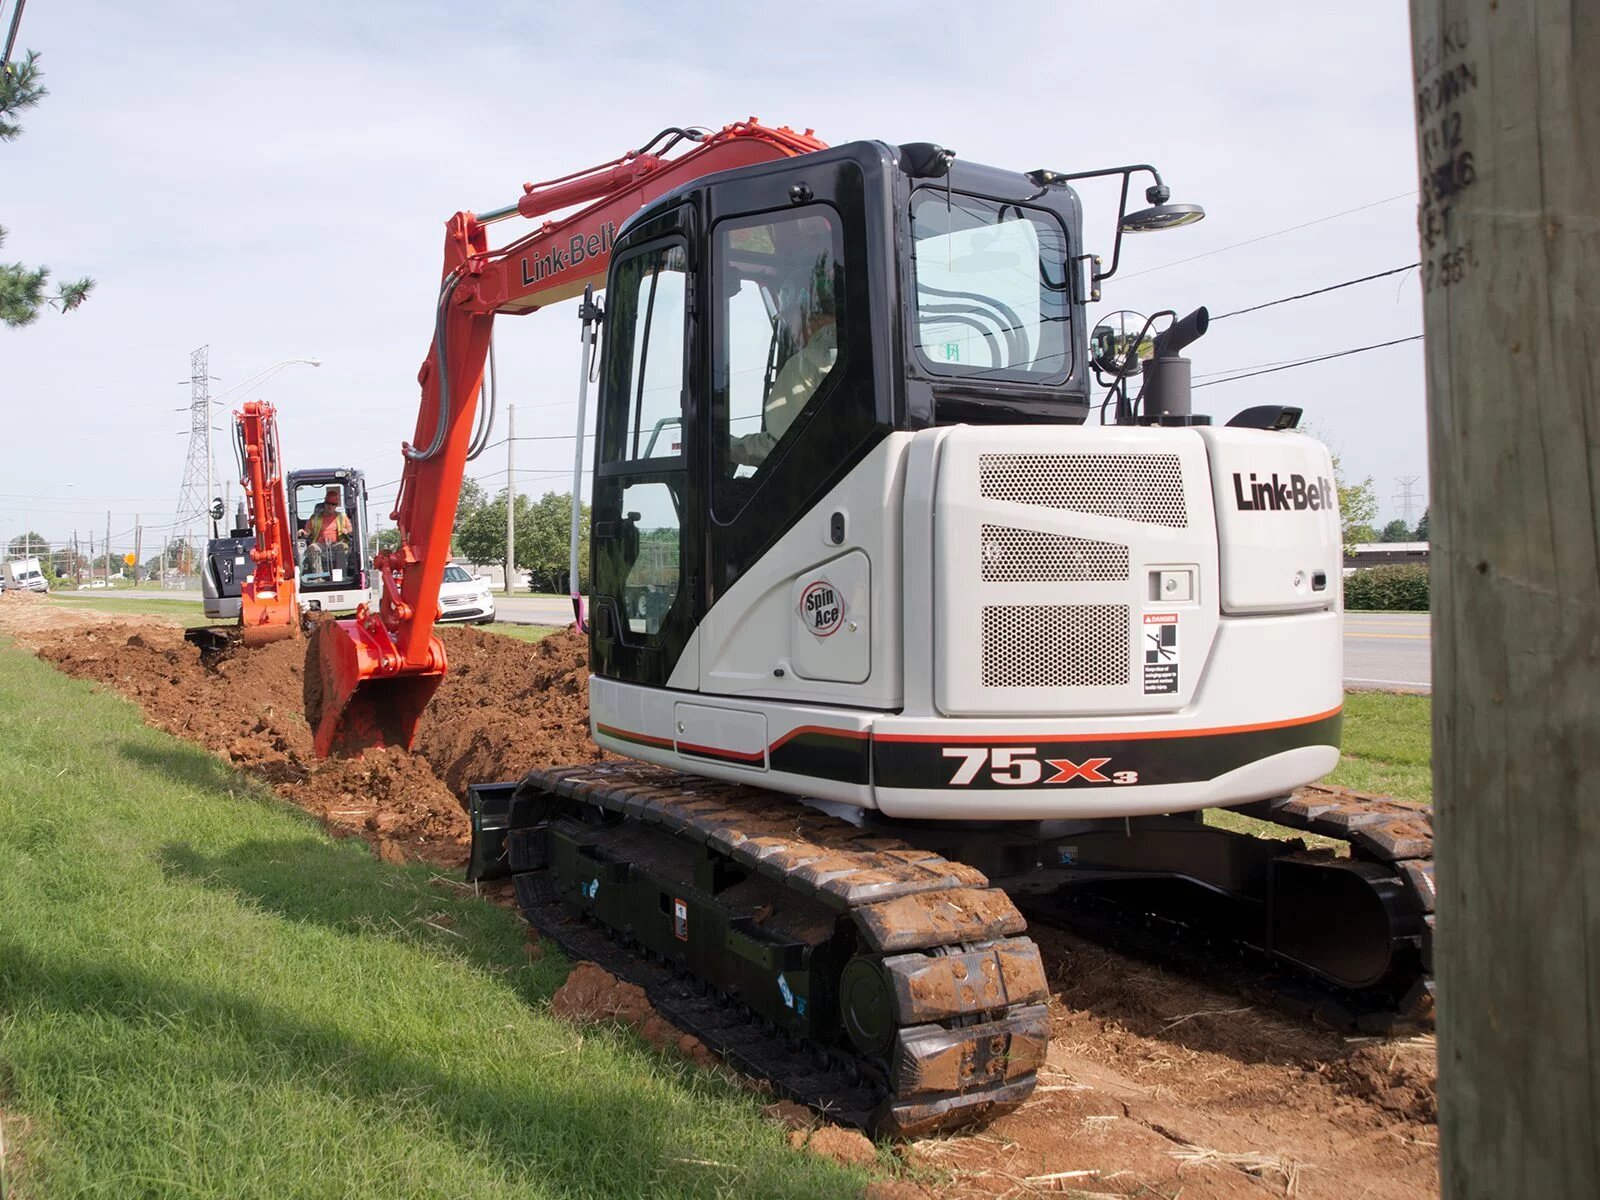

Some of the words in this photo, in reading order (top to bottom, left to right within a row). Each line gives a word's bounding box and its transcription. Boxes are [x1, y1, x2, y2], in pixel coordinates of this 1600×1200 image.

[521, 221, 616, 287] Link-Belt
[1232, 472, 1333, 511] Link-Belt
[806, 589, 834, 612] Spin
[815, 607, 839, 628] Ace
